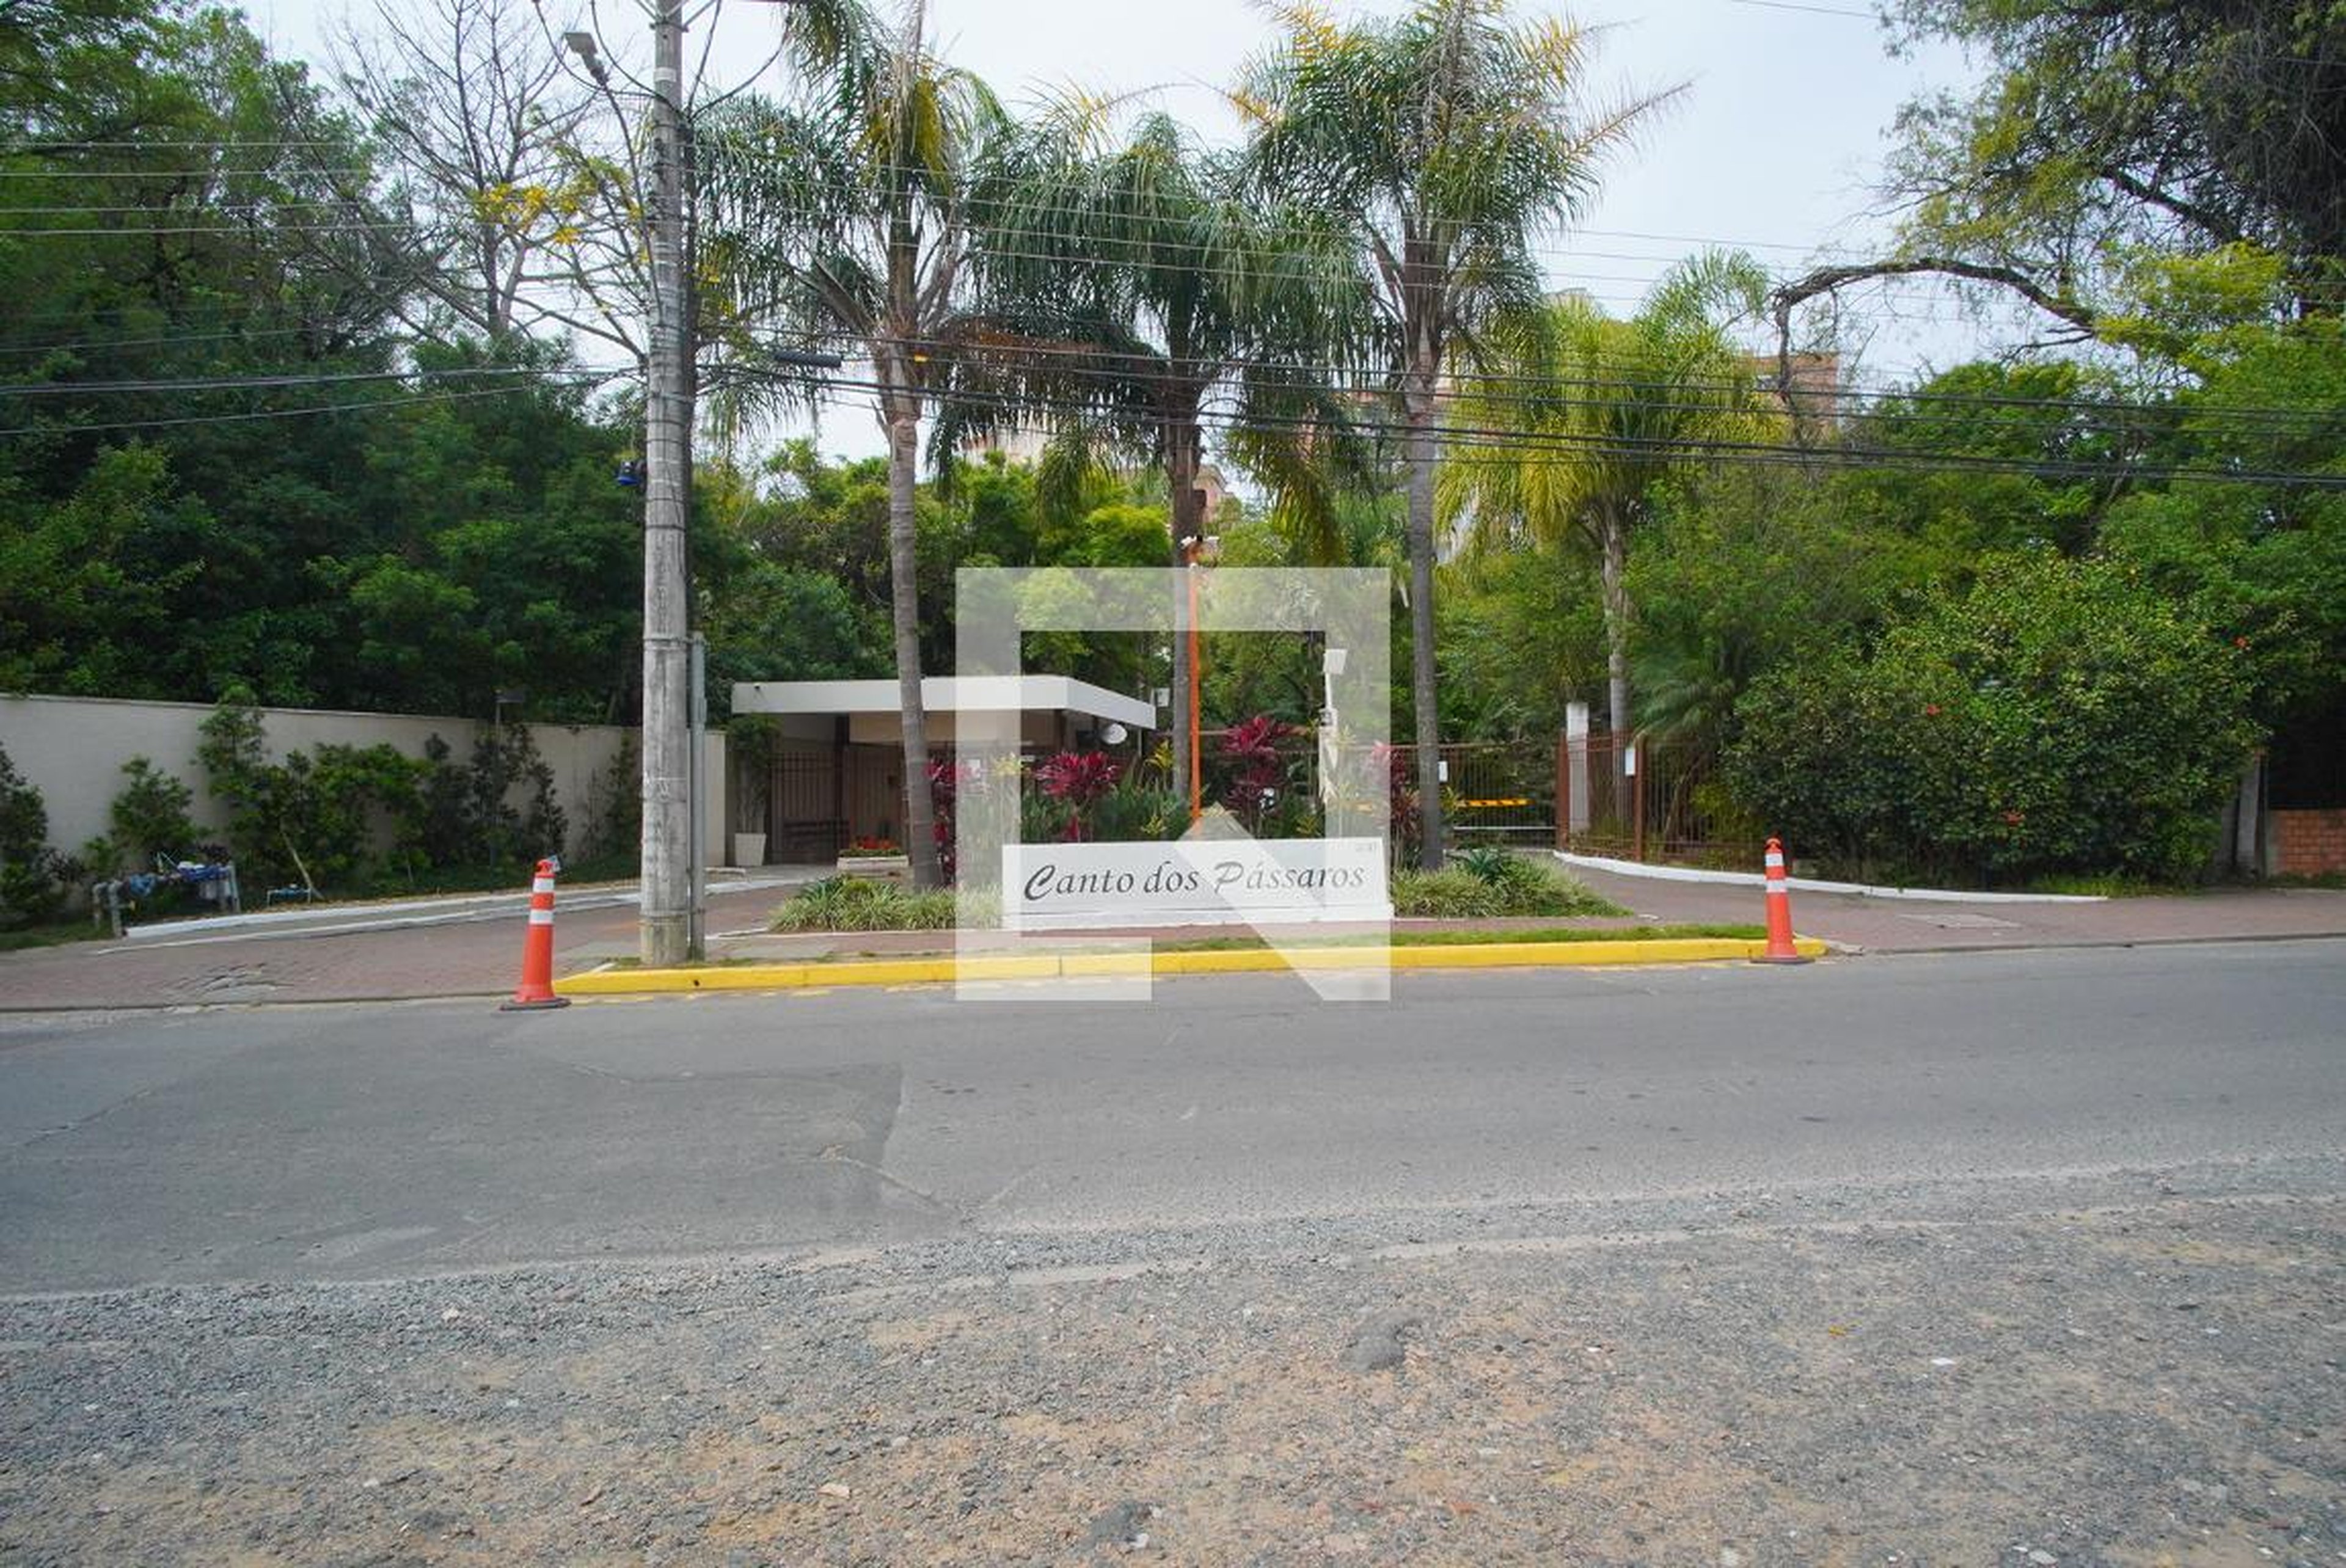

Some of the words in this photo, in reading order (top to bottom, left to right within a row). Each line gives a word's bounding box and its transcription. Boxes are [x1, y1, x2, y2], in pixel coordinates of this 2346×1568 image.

[1024, 864, 1134, 900] Canto
[1144, 861, 1199, 893] dos
[1214, 861, 1365, 894] Pássaros
